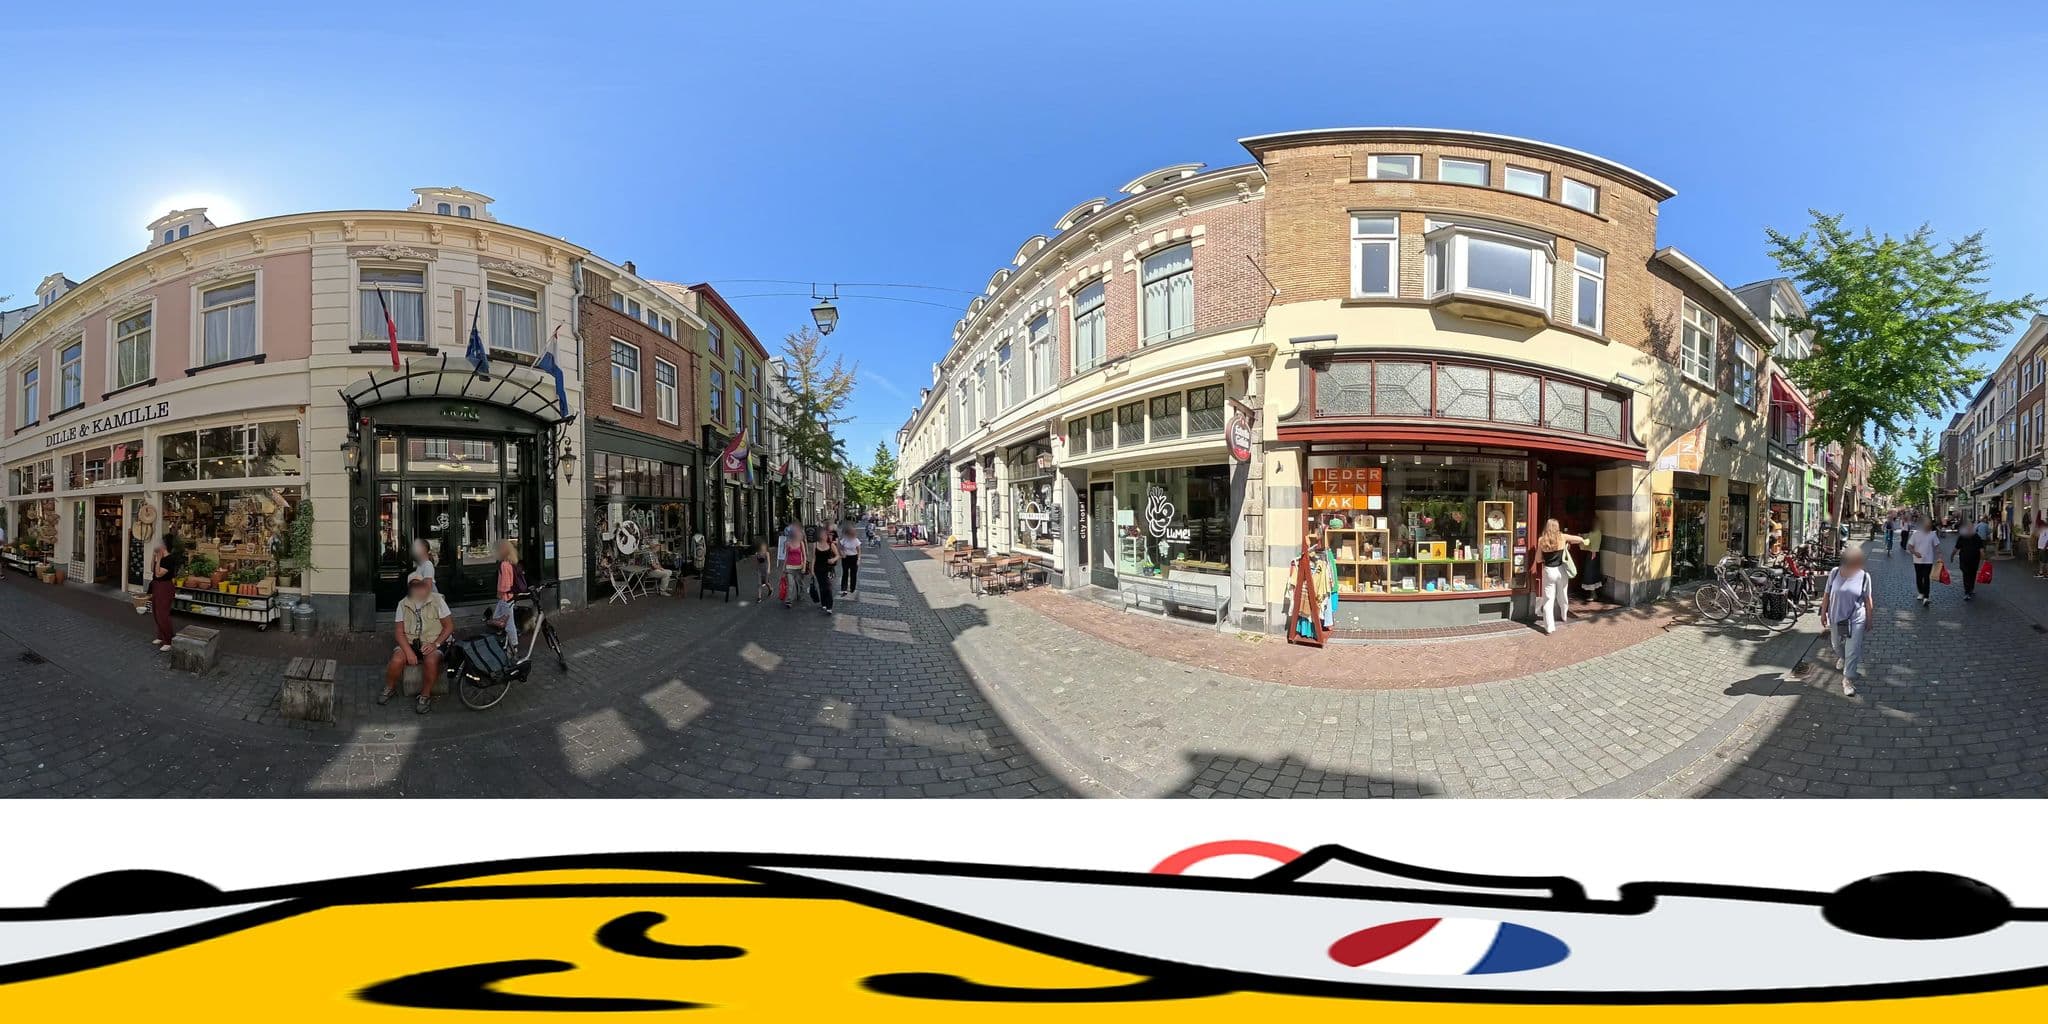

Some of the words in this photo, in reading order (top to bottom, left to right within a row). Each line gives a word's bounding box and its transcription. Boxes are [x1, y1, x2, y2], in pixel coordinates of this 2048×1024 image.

[46, 426, 77, 447] DILLE
[79, 423, 90, 438] &
[91, 401, 169, 434] KAMILLE
[1317, 470, 1381, 480] IEDER
[1328, 483, 1367, 494] Z'N
[1314, 497, 1353, 508] VAK
[1079, 524, 1087, 539] city
